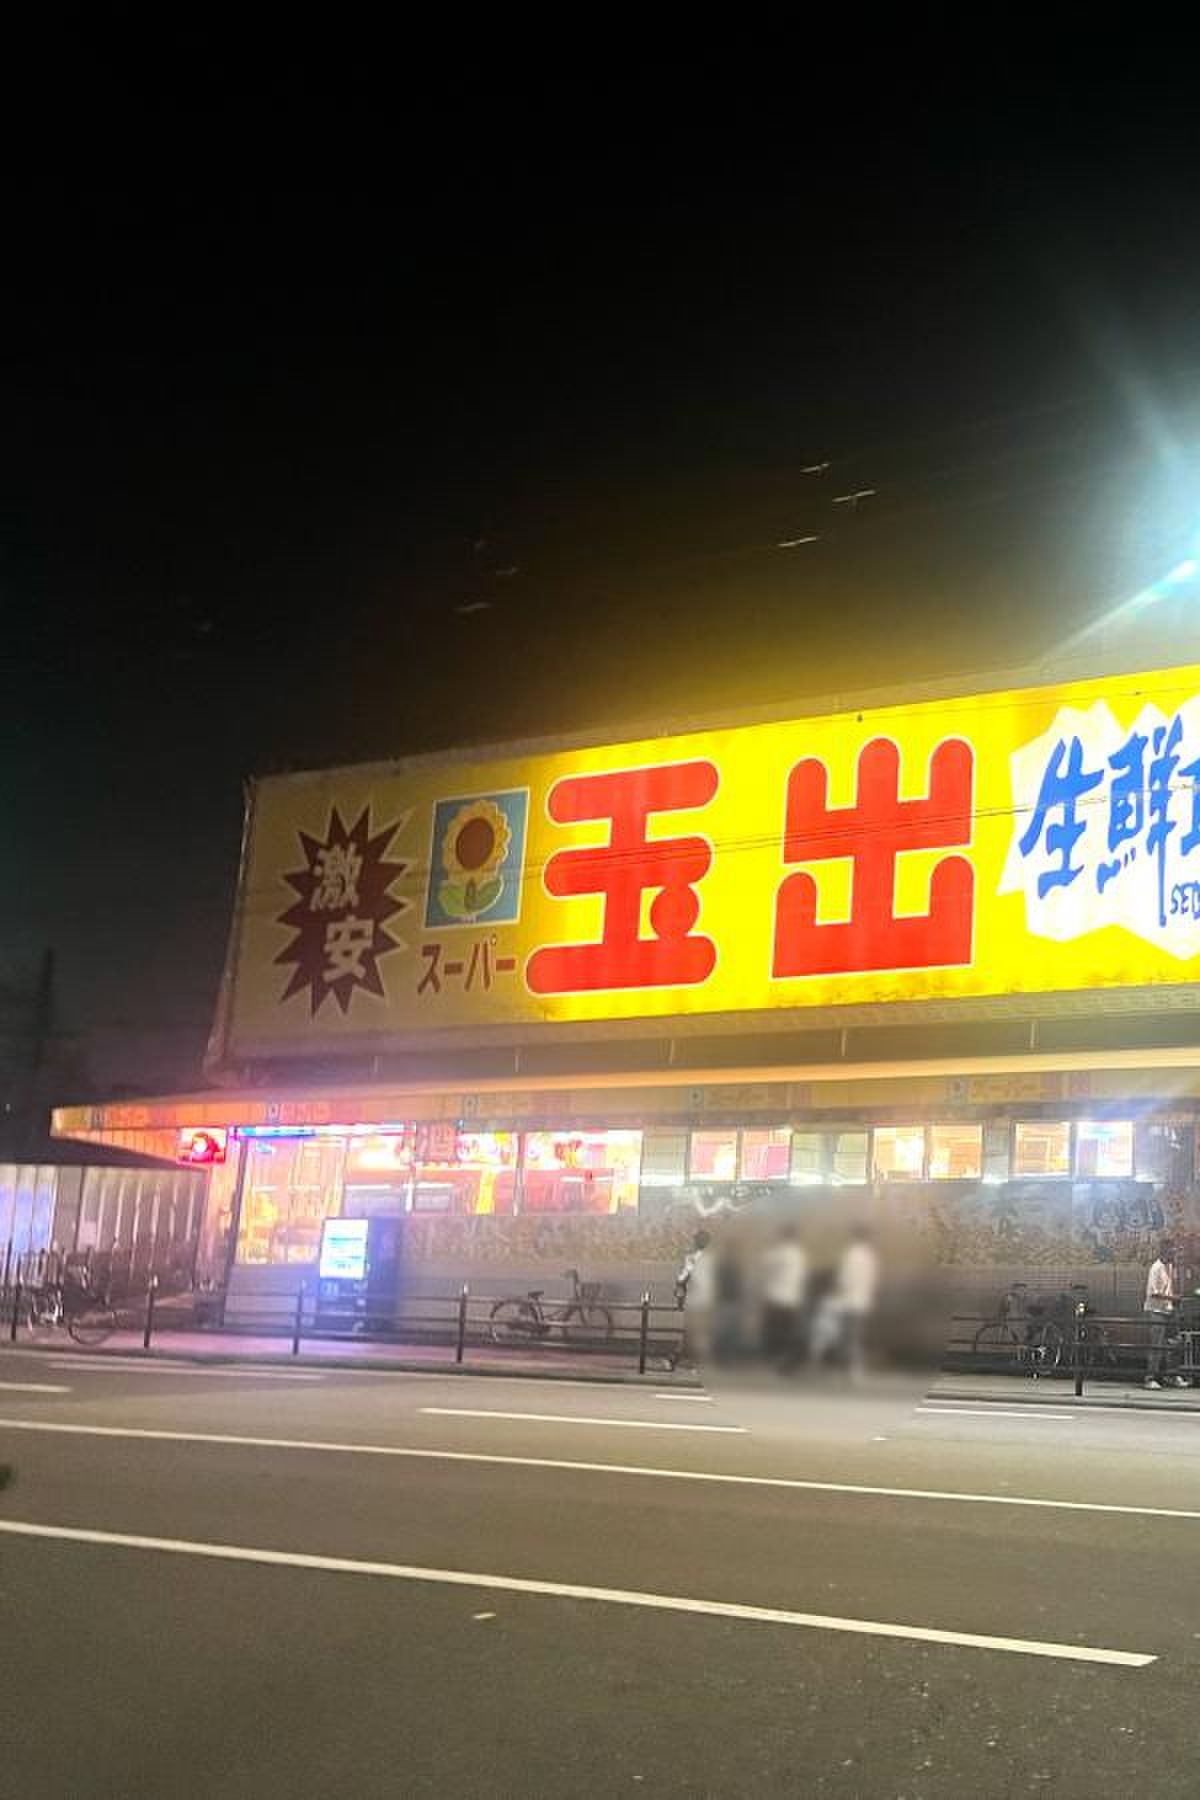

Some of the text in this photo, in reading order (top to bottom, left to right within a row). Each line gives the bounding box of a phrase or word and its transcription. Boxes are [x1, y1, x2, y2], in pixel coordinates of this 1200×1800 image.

[312, 841, 375, 983] 激安
[416, 734, 975, 997] スーパー 玉出
